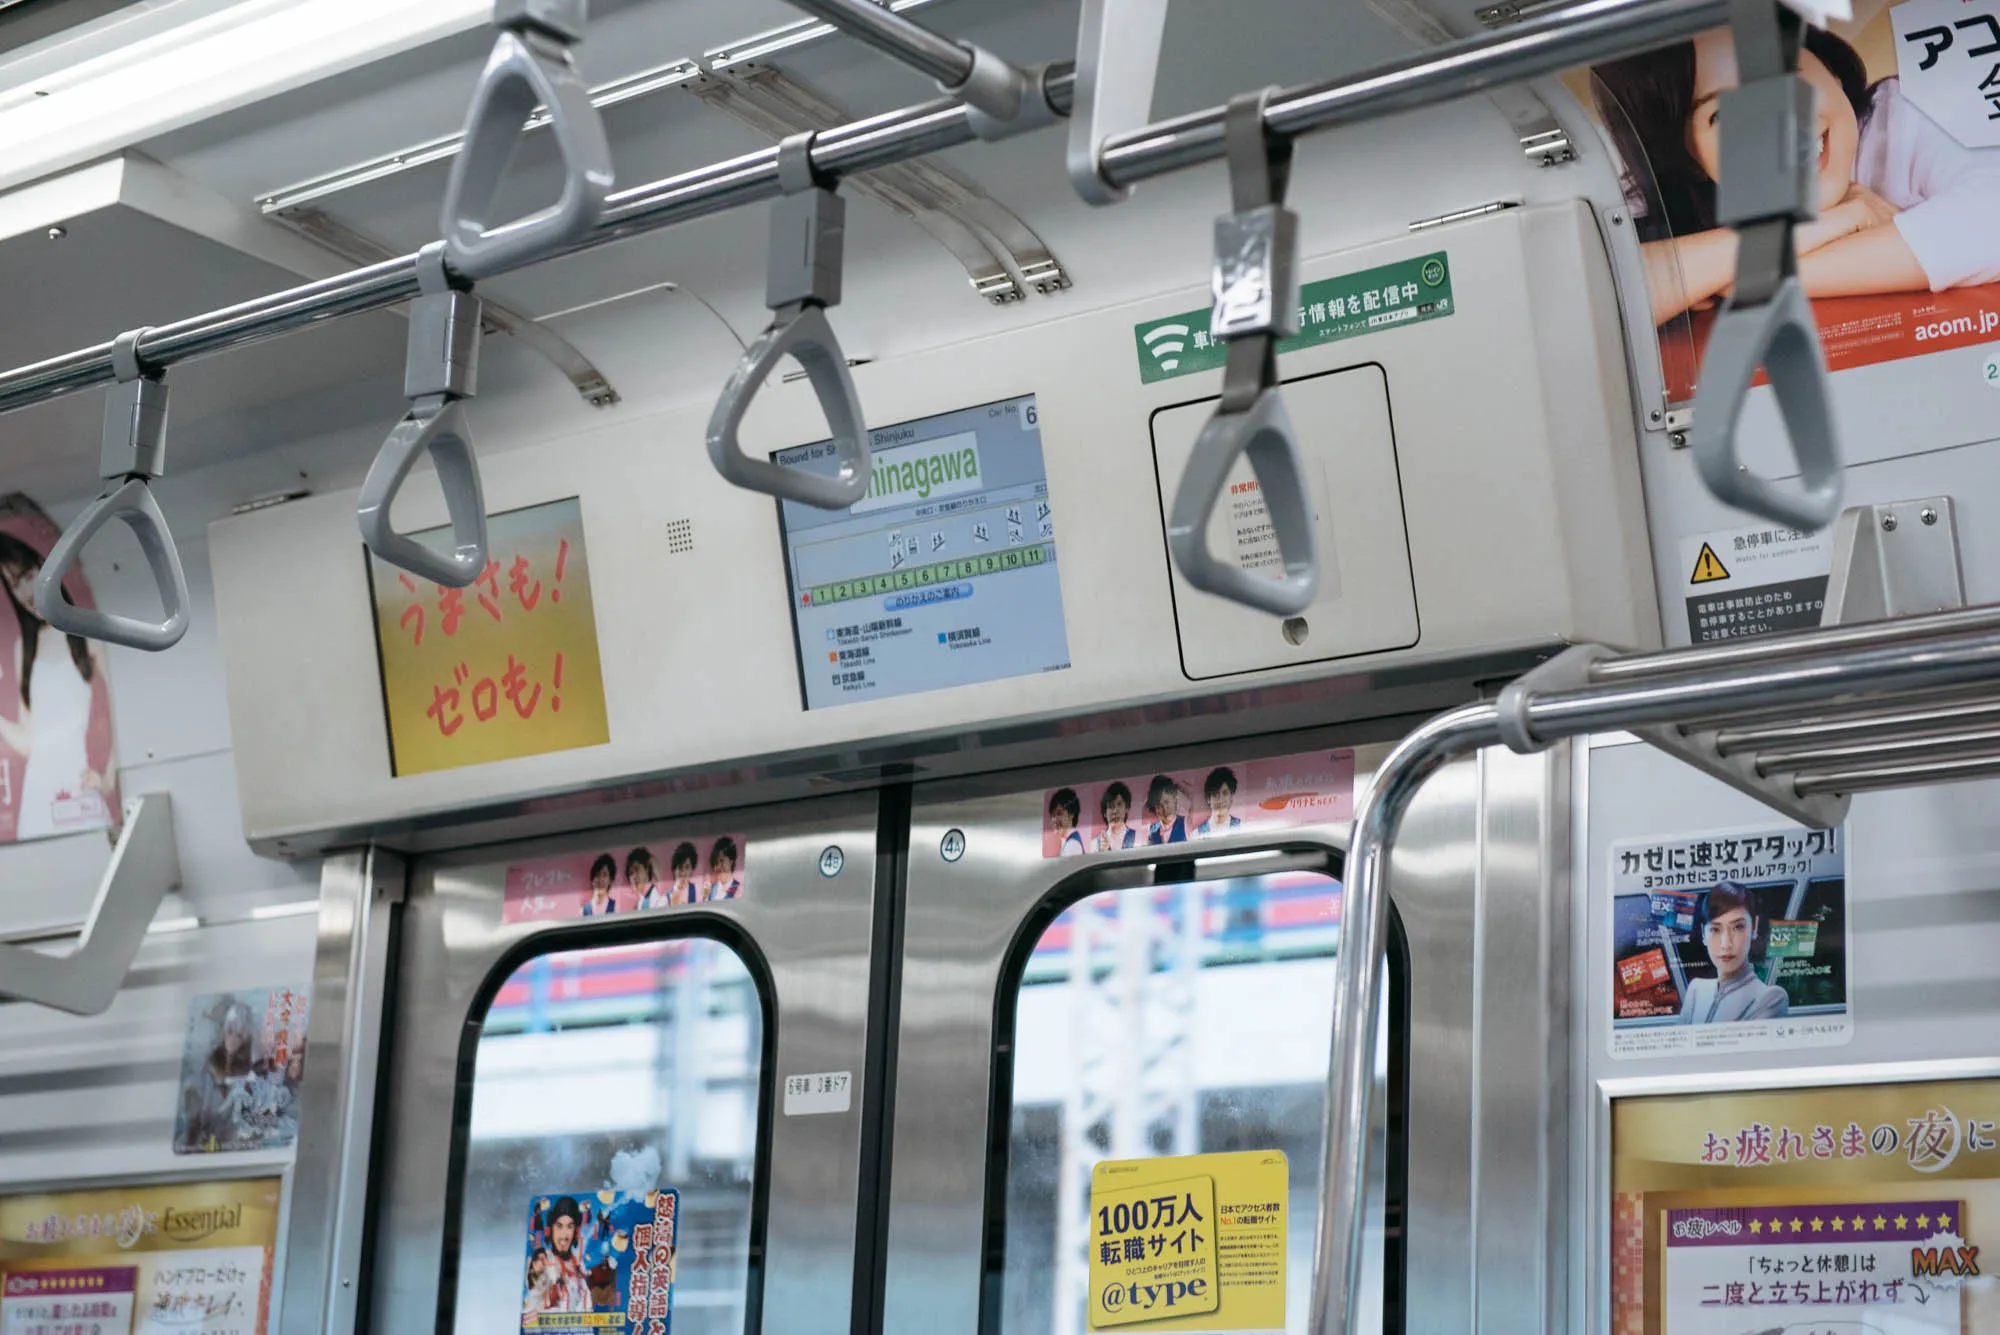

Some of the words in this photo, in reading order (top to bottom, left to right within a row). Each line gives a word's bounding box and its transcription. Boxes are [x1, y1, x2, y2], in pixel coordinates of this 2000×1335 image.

[1915, 309, 1999, 341] acom.jp
[1026, 405, 1037, 424] 6
[780, 451, 809, 465] Bound
[811, 449, 823, 460] for
[873, 428, 915, 447] Shinjuku
[862, 446, 979, 499] hinagawa
[820, 591, 825, 601] 1
[839, 587, 846, 597] 2
[860, 583, 866, 593] 3
[880, 579, 887, 589] 4
[901, 574, 908, 585] 5
[922, 570, 929, 581] 6
[944, 566, 950, 577] 7
[965, 562, 972, 573] 8
[986, 558, 993, 569] 9
[1007, 554, 1018, 565] 10
[1030, 550, 1039, 561] 11
[1697, 591, 1793, 614] 電車は事故防止のため
[427, 652, 564, 736] ゼロも！
[1621, 829, 1837, 875] カゼに速攻アタック！
[1643, 859, 1812, 889] 3つのカゼに3つのルルアタック！
[1701, 1109, 1997, 1168] お疲れさまの夜に
[164, 1203, 242, 1233] Essential
[1098, 1192, 1204, 1236] 100万人
[1673, 1217, 1742, 1240] お疲レベル
[1100, 1228, 1205, 1266] 転職サイト
[1749, 1253, 1876, 1275] 「ちょっと休憩」は
[1911, 1247, 1980, 1277] MAX
[1102, 1278, 1207, 1314] @type
[1701, 1277, 1905, 1305] 二度と立ち上がれず
